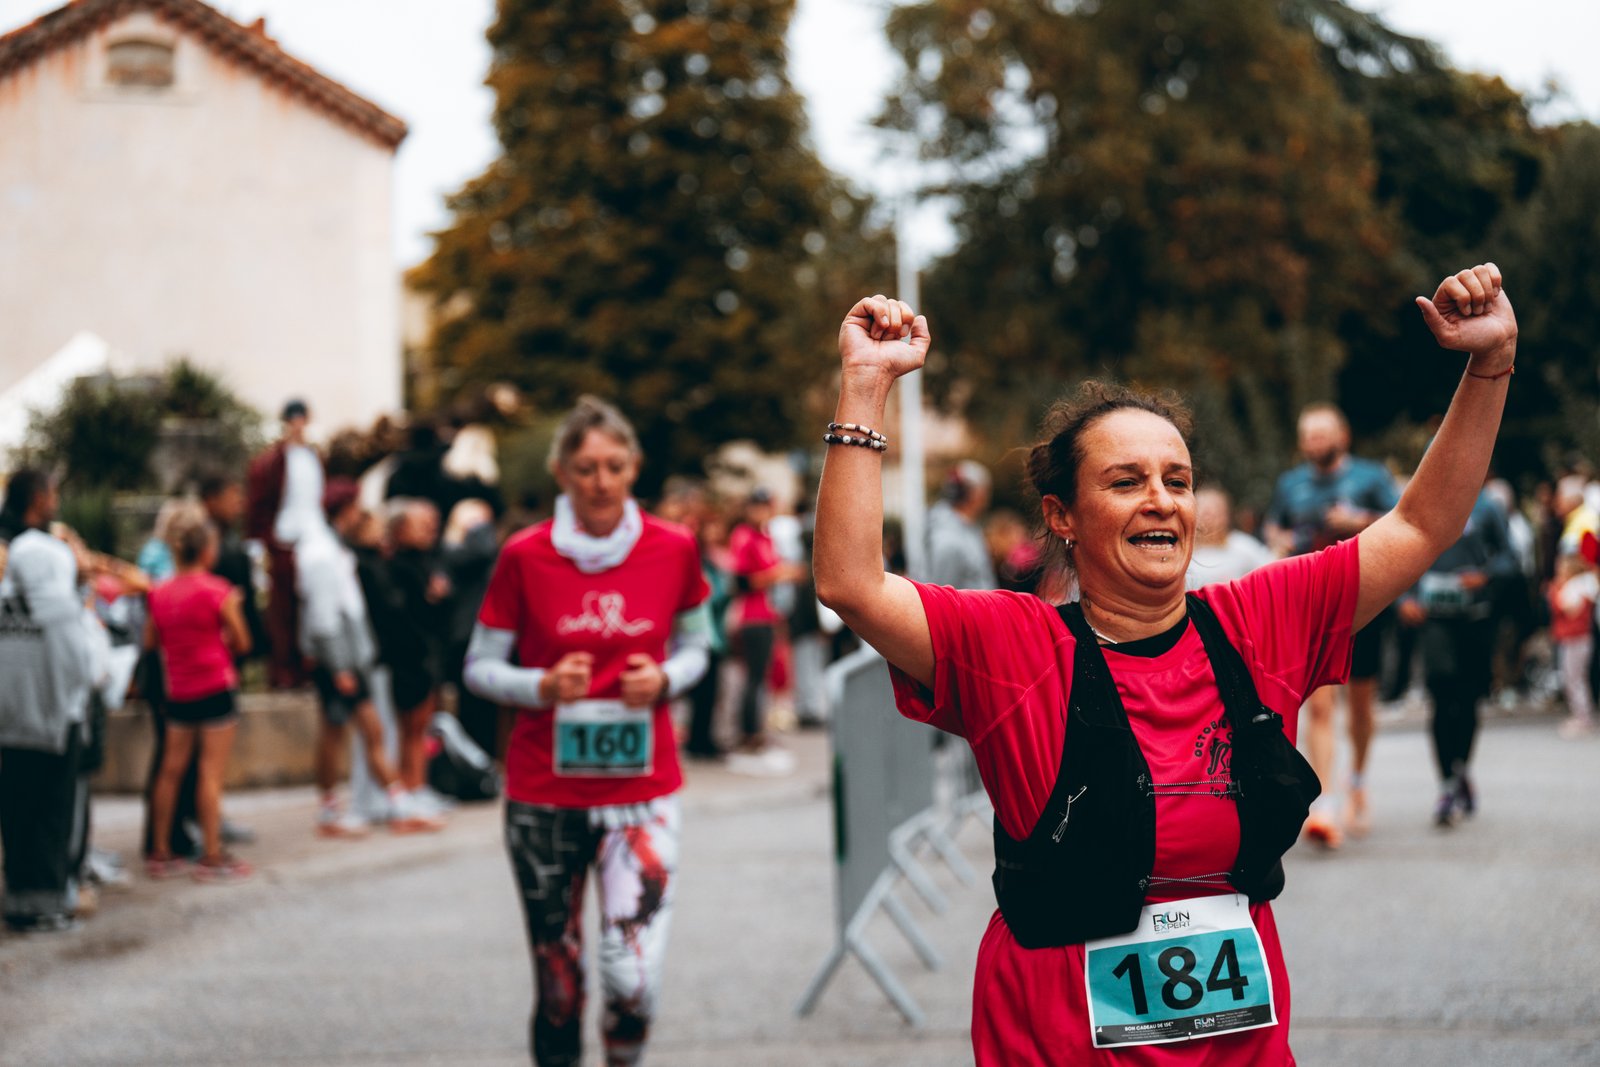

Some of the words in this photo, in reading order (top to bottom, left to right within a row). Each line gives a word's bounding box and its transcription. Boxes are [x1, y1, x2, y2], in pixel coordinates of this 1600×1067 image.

[570, 725, 641, 760] 160
[1153, 911, 1190, 925] RUN
[1154, 921, 1190, 931] EXPERT
[1112, 939, 1249, 1015] 184
[1136, 1023, 1157, 1031] CADEAU
